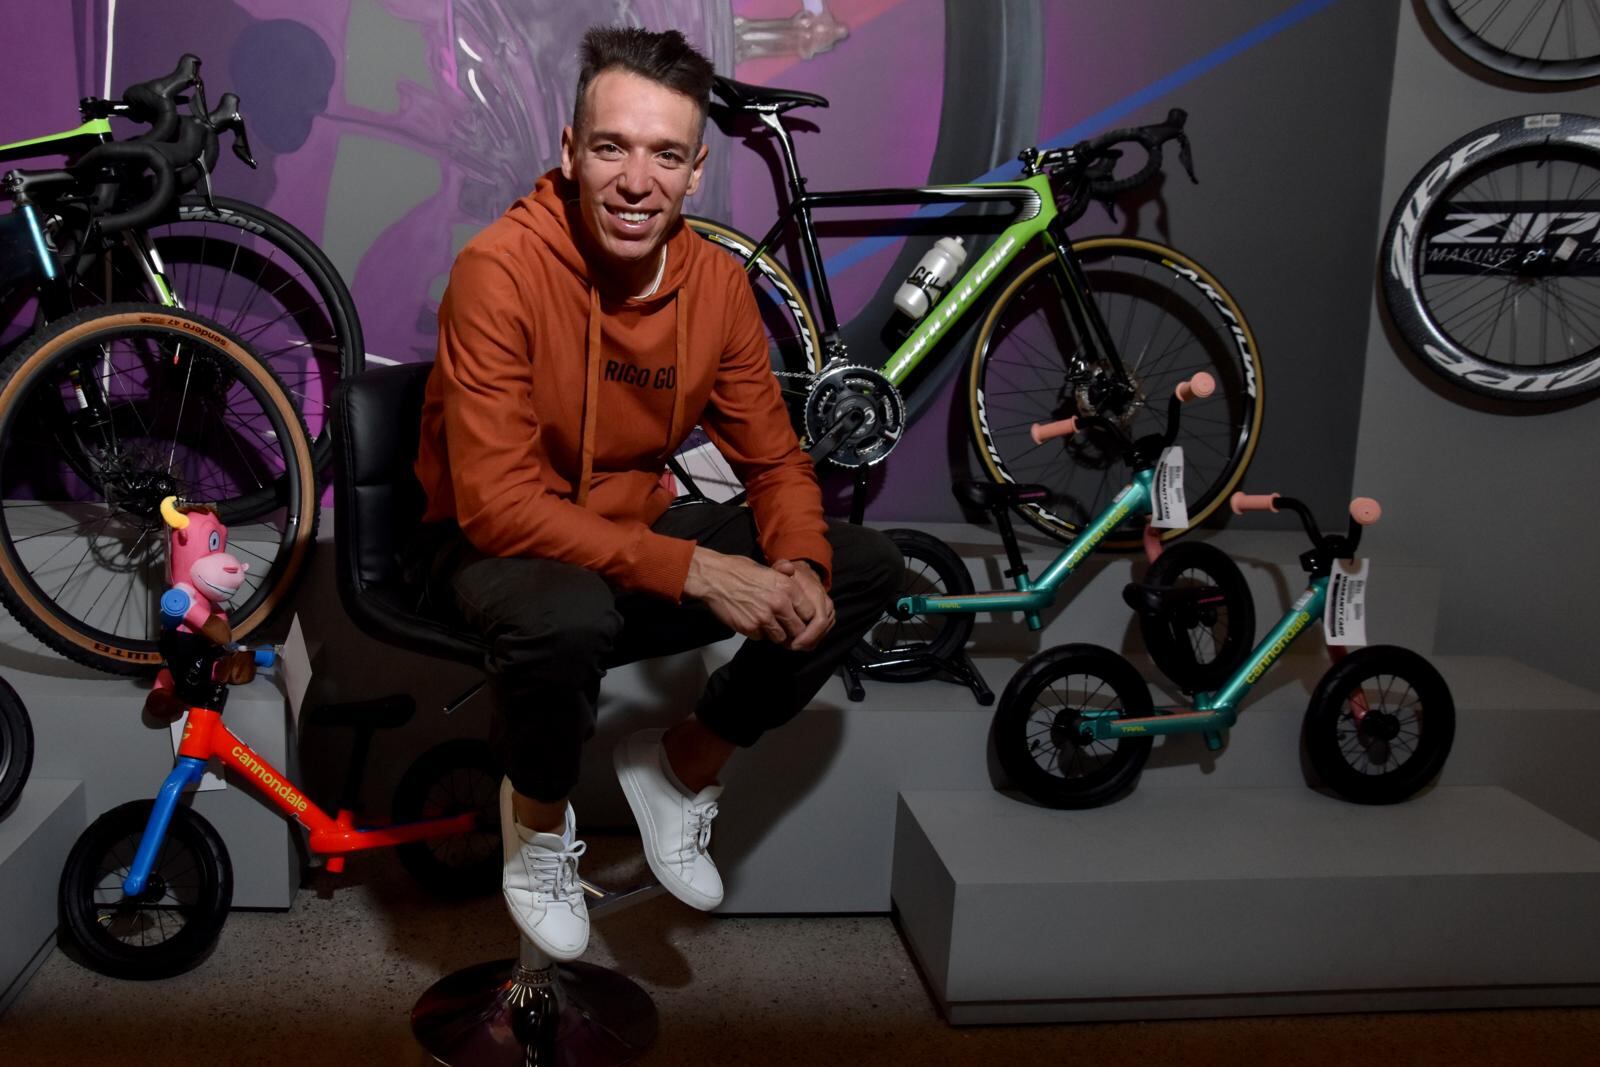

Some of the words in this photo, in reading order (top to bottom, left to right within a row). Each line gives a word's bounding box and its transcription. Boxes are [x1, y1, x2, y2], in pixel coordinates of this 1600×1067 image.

[1430, 212, 1600, 243] ZIP
[183, 322, 227, 346] sendero
[604, 359, 651, 388] RIGO
[1246, 611, 1311, 684] cannondale
[231, 746, 307, 812] cannondale
